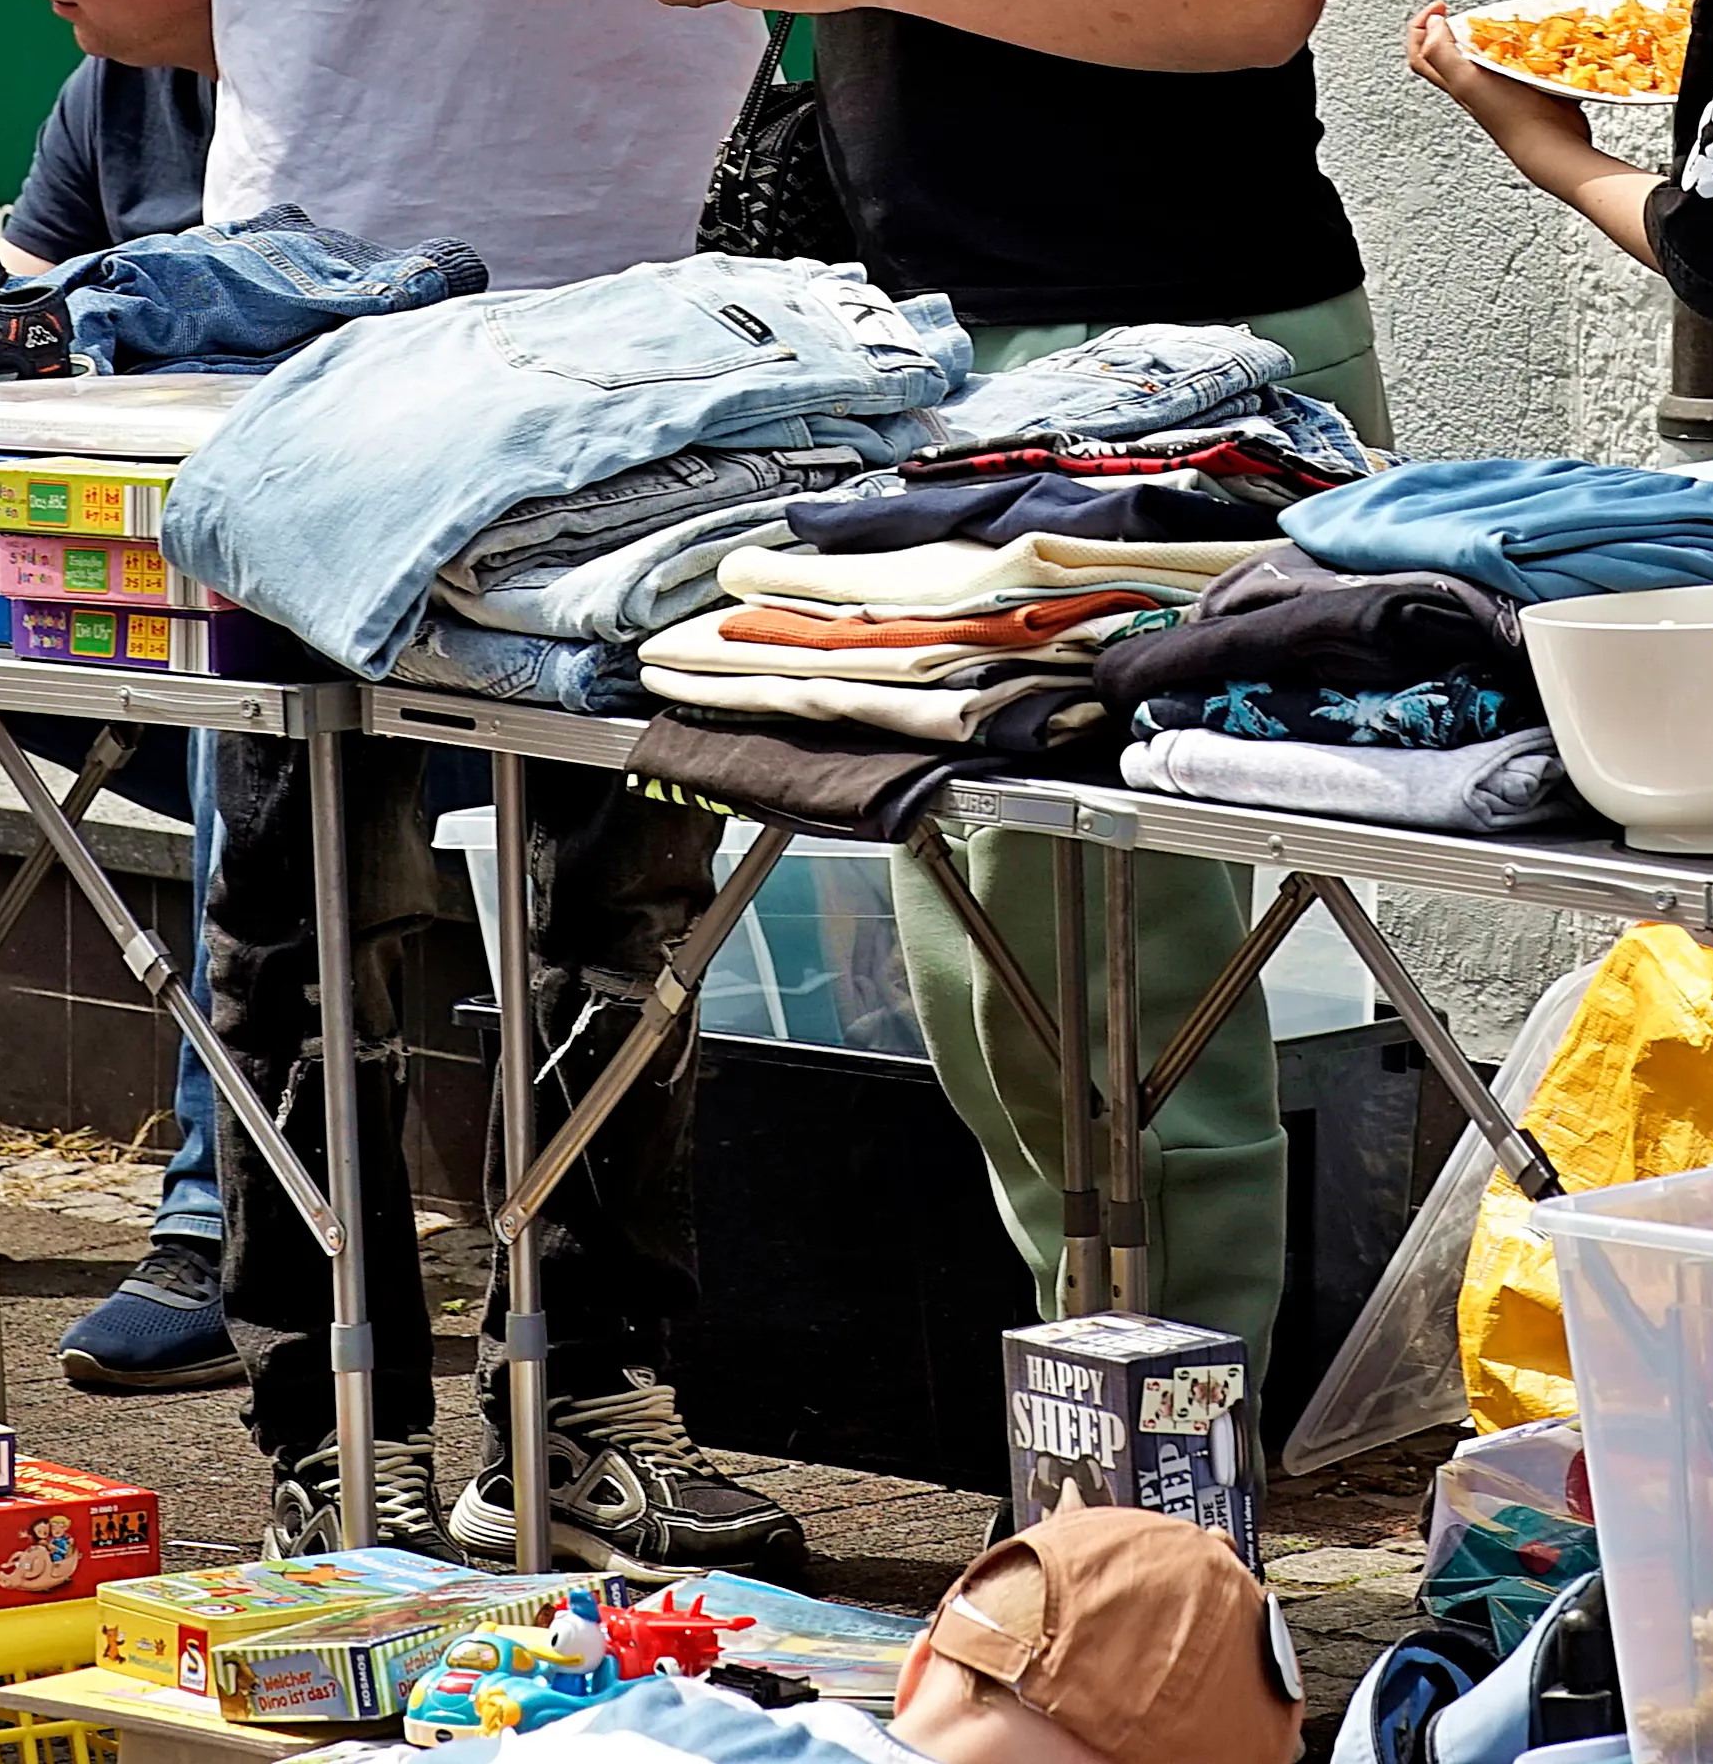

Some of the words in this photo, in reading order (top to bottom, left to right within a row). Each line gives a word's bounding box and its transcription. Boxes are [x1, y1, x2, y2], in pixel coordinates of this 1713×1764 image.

[1026, 1354, 1104, 1407] HAPPY
[1011, 1391, 1126, 1470] SHEEP
[258, 1692, 289, 1713] Dino
[290, 1688, 306, 1706] ist
[307, 1681, 339, 1702] das?
[262, 1670, 313, 1693] Welcher
[355, 1653, 373, 1708] KOSMOS
